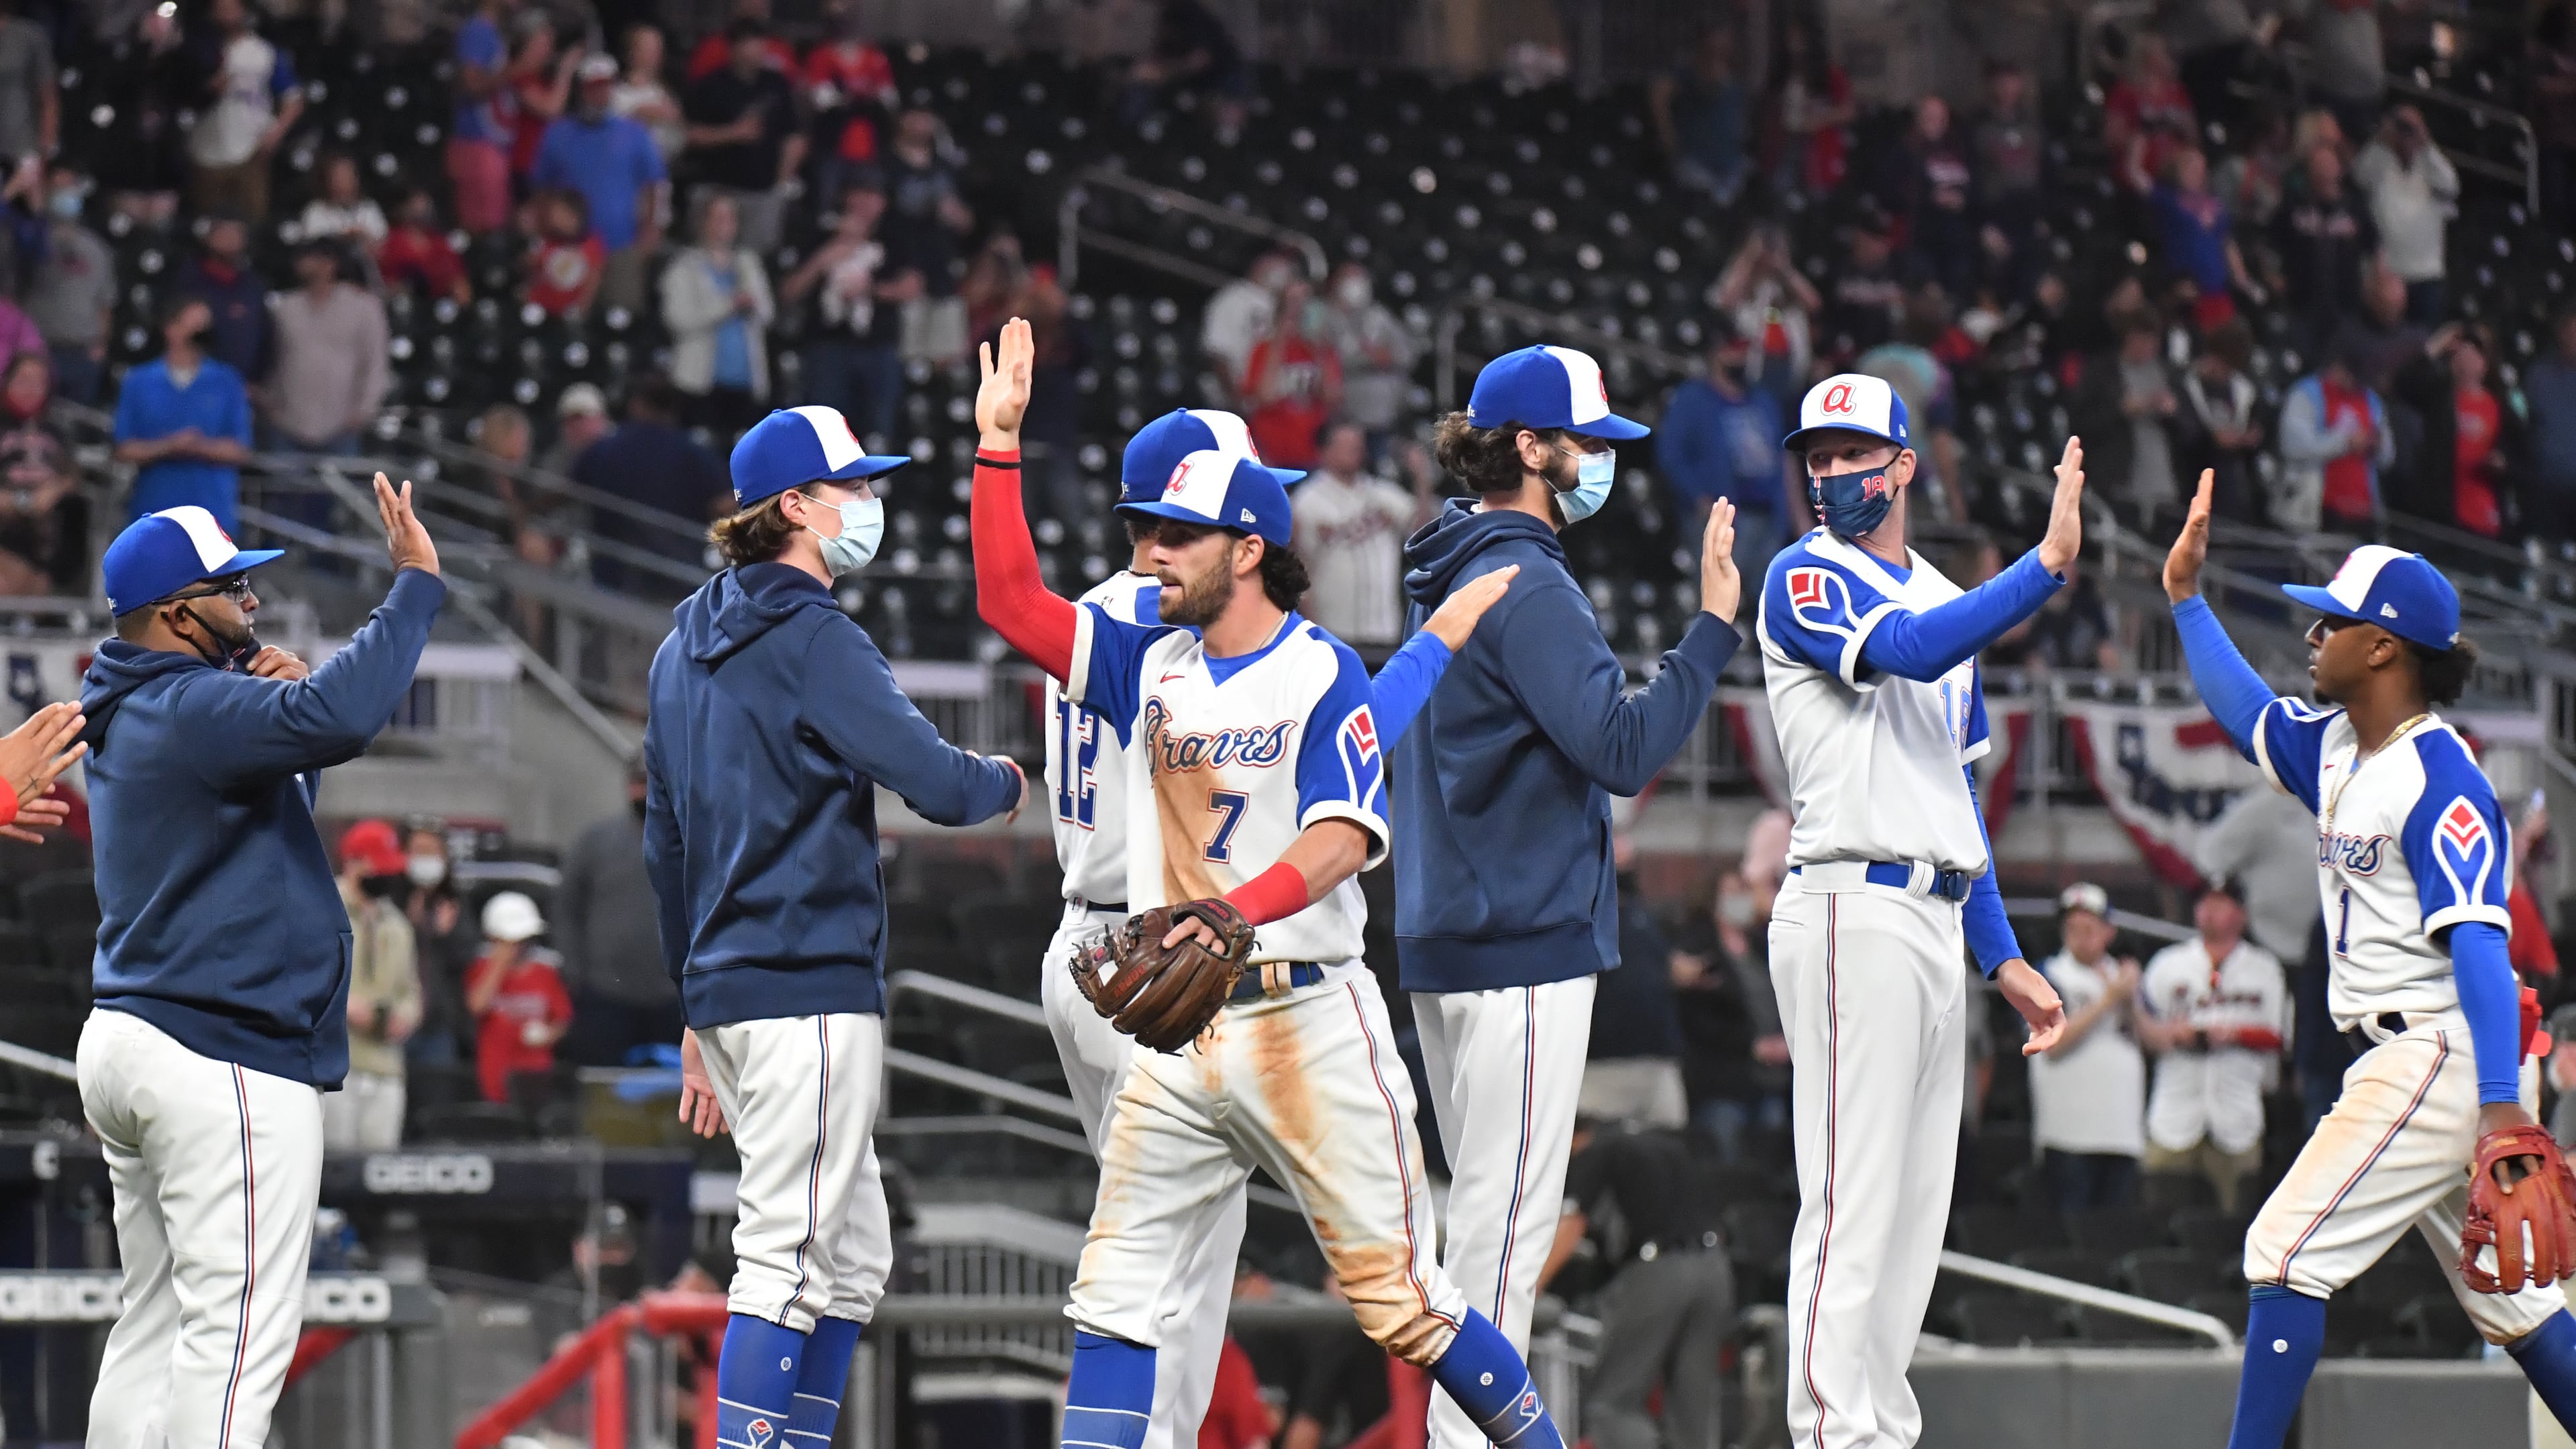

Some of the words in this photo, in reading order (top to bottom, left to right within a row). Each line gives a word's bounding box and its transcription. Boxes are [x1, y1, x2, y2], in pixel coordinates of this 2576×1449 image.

[1862, 475, 1886, 502] 18
[1055, 686, 1102, 831] 12
[1144, 695, 1298, 789] Braves
[1203, 788, 1249, 864] 7
[2334, 885, 2351, 959] 1
[364, 1154, 494, 1194] GEICO
